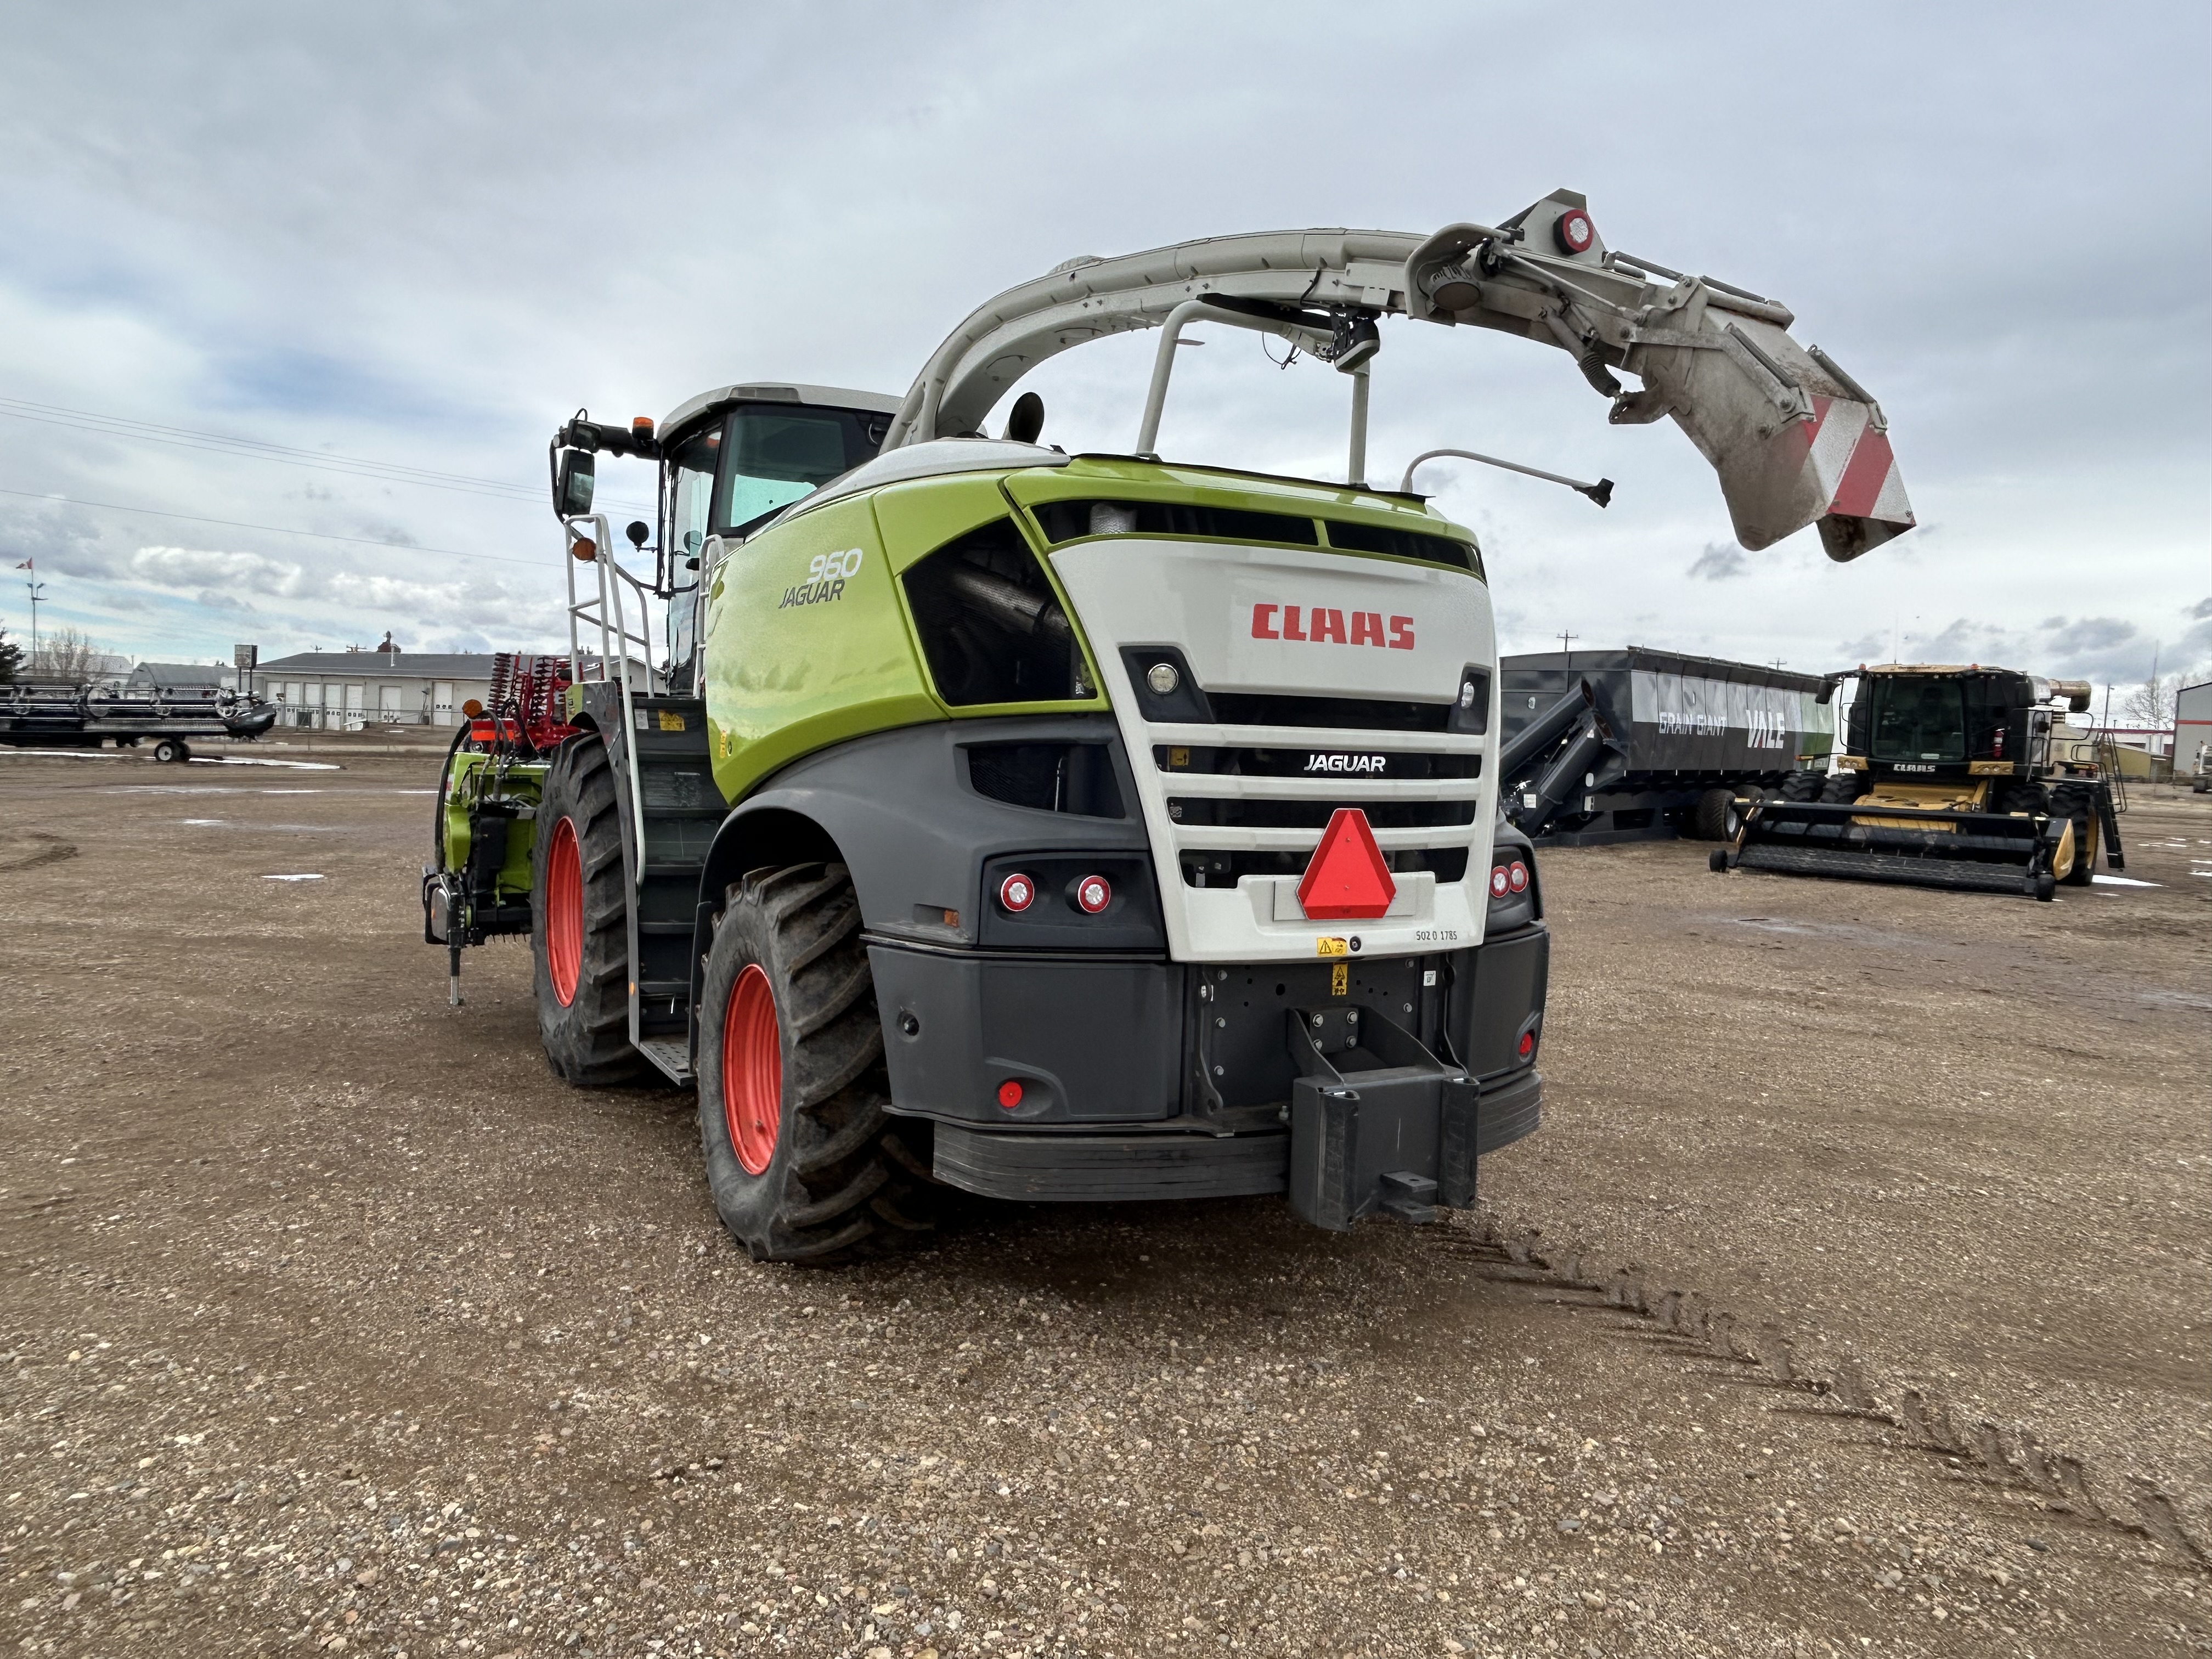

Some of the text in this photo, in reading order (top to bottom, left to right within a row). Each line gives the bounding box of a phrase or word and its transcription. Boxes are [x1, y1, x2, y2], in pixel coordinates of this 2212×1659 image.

[806, 548, 863, 584] 960
[778, 579, 845, 609] JAGUAR
[1251, 603, 1415, 650] CLAAS
[1659, 712, 1726, 736] GRAIN GIANT
[1746, 709, 1785, 748] VALE
[1304, 754, 1386, 772] JAGUAR
[1441, 930, 1457, 940] 1785
